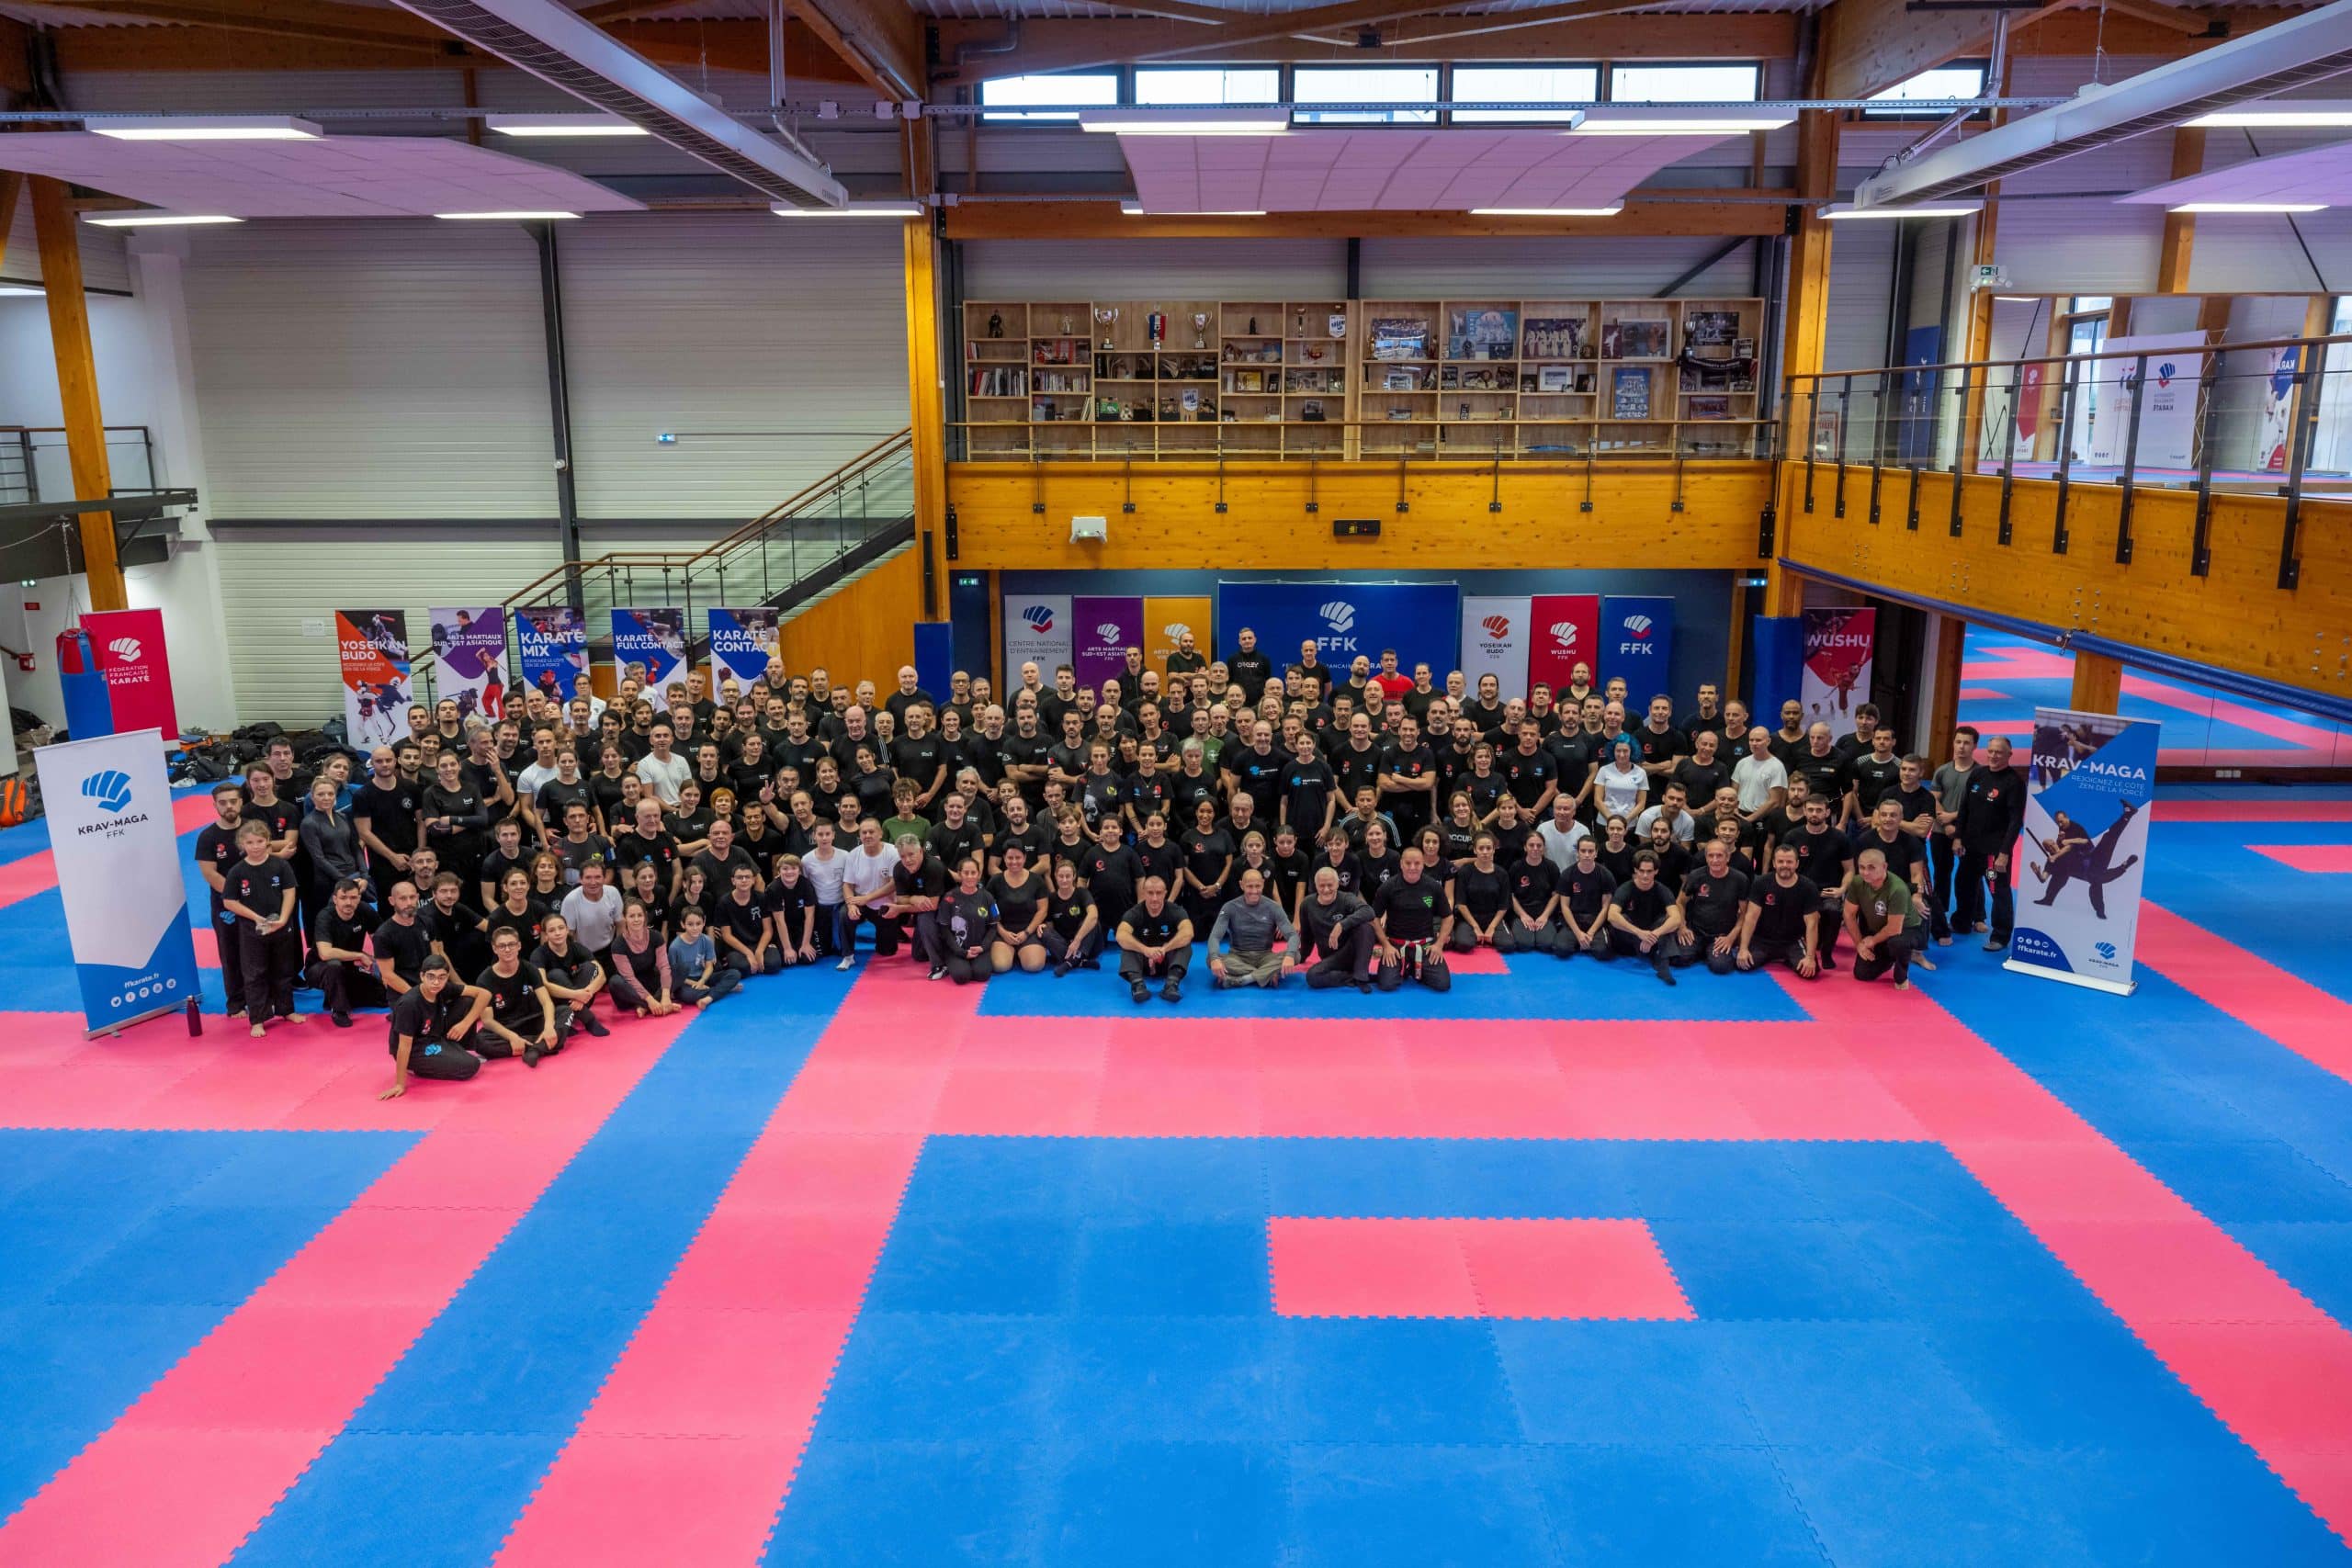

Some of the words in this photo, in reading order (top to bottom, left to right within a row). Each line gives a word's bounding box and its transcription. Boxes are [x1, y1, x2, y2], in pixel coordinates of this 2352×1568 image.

[341, 640, 407, 650] YOSEIKAN
[616, 642, 639, 650] FULL
[640, 641, 684, 649] CONTACT
[714, 641, 777, 652] CONTACT
[1317, 637, 1358, 651] FFK
[1806, 634, 1871, 648] WUSHU
[522, 645, 550, 657] MIX
[1620, 642, 1654, 655] FFK
[342, 650, 377, 660] BUDO
[2032, 753, 2147, 781] KRAV-MAGA
[2078, 782, 2094, 790] ZEN
[78, 813, 149, 836] KRAV-MAGA
[106, 829, 125, 839] FFK
[2017, 944, 2058, 959] ffkarate.fr
[124, 972, 160, 989] ffkarate.fr
